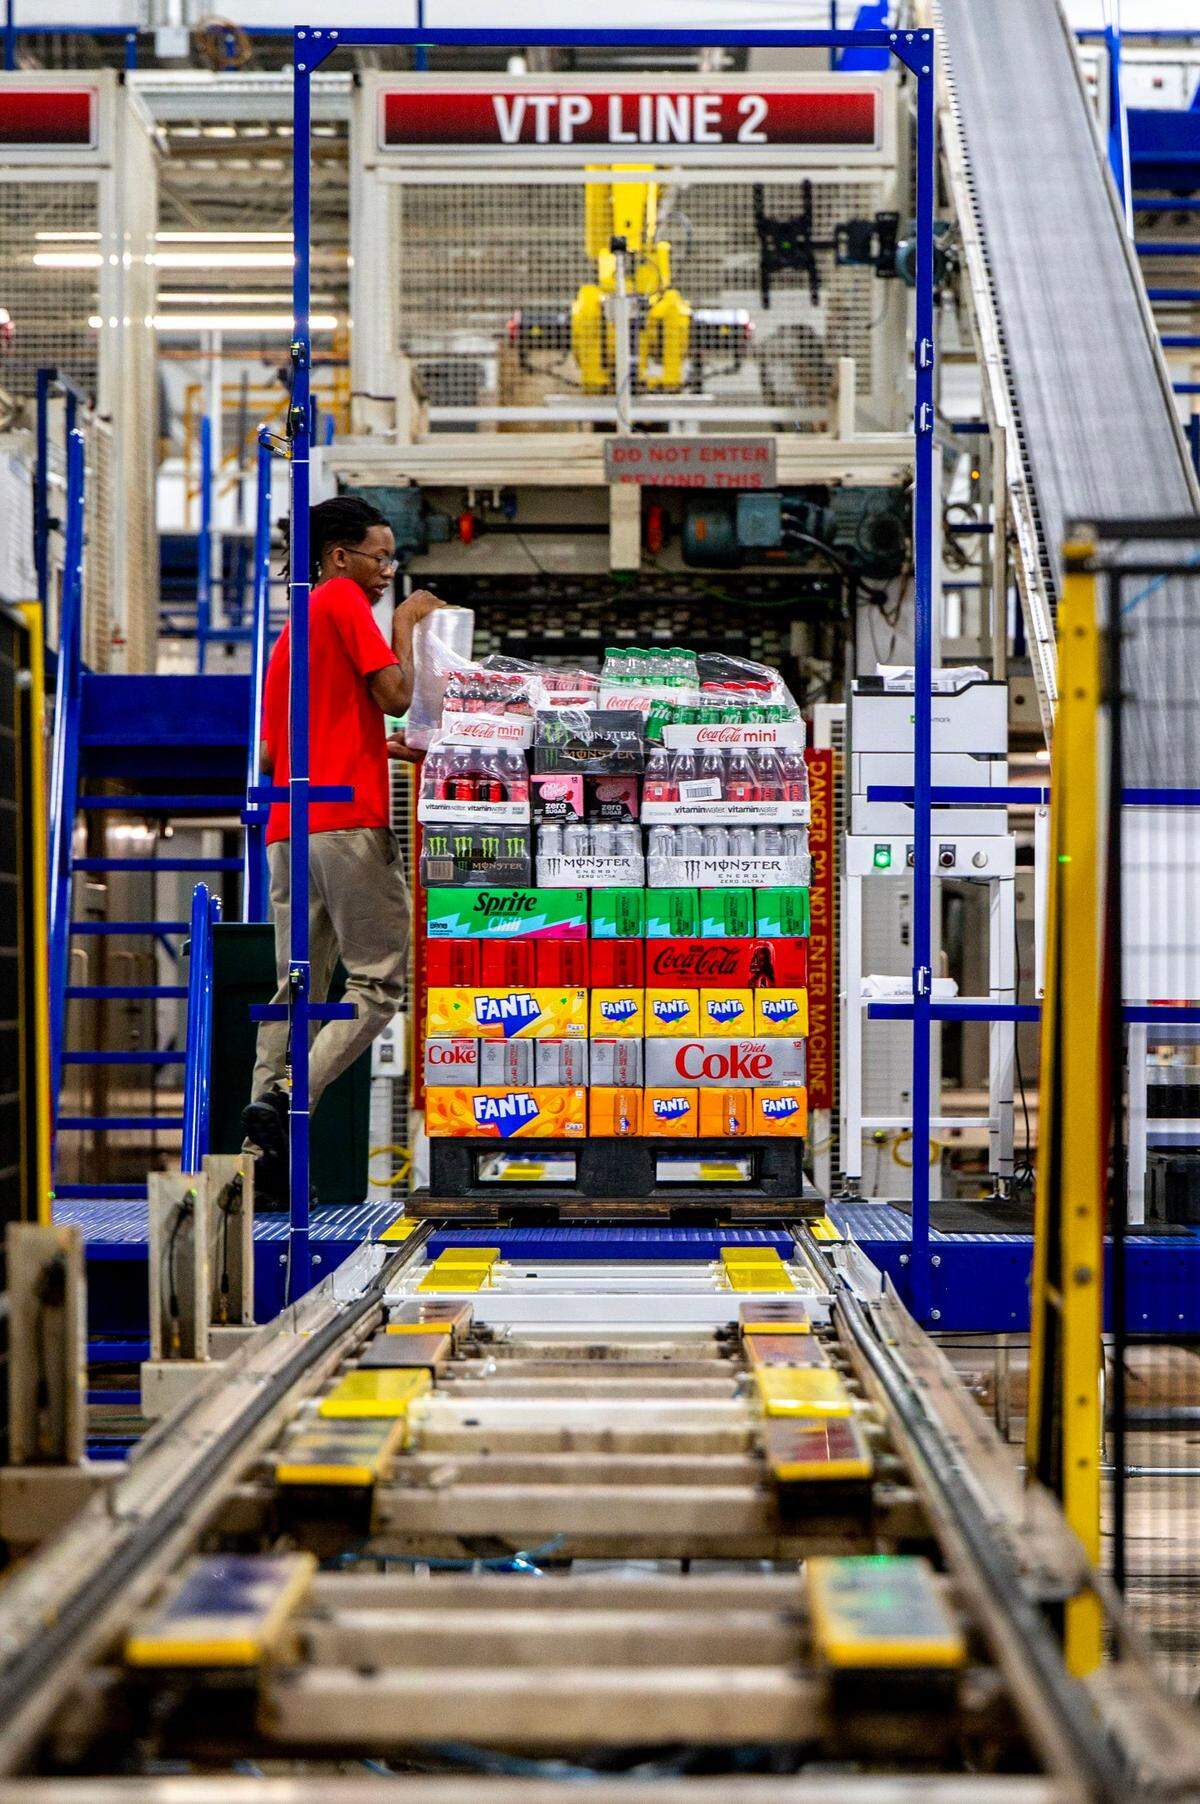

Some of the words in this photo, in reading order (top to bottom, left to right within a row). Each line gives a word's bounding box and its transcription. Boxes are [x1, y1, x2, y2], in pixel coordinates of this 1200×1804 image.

[492, 94, 592, 143] VTP
[608, 94, 722, 143] LINE
[737, 94, 768, 143] 2
[612, 447, 642, 463] DO
[649, 447, 691, 463] NOT
[699, 447, 769, 463] ENTER
[713, 473, 762, 488] THIS
[498, 726, 525, 737] mini
[744, 729, 776, 742] mini
[674, 805, 725, 814] vitaminwater
[727, 804, 779, 814] vitaminwater
[808, 761, 827, 843] DANGER
[472, 862, 523, 871] MONSTER
[564, 857, 631, 868] MONSTER
[704, 858, 782, 872] MONSTER
[811, 850, 827, 880] DO
[473, 891, 538, 916] Sprite
[810, 886, 827, 927] NOT
[808, 934, 827, 997] ENTER
[577, 990, 585, 998] 12
[475, 993, 541, 1020] FANTA
[601, 999, 637, 1015] FANTA
[653, 999, 690, 1015] FANTA
[707, 999, 744, 1015] FANTA
[762, 999, 799, 1015] FANTA
[740, 1041, 766, 1053] Diet
[793, 1041, 801, 1049] 12
[808, 1003, 827, 1096] MACHINE
[428, 1045, 476, 1064] Coke
[675, 1043, 773, 1080] Coke
[473, 1093, 539, 1119] FANTA
[653, 1098, 690, 1115] FANTA
[762, 1098, 799, 1115] FANTA
